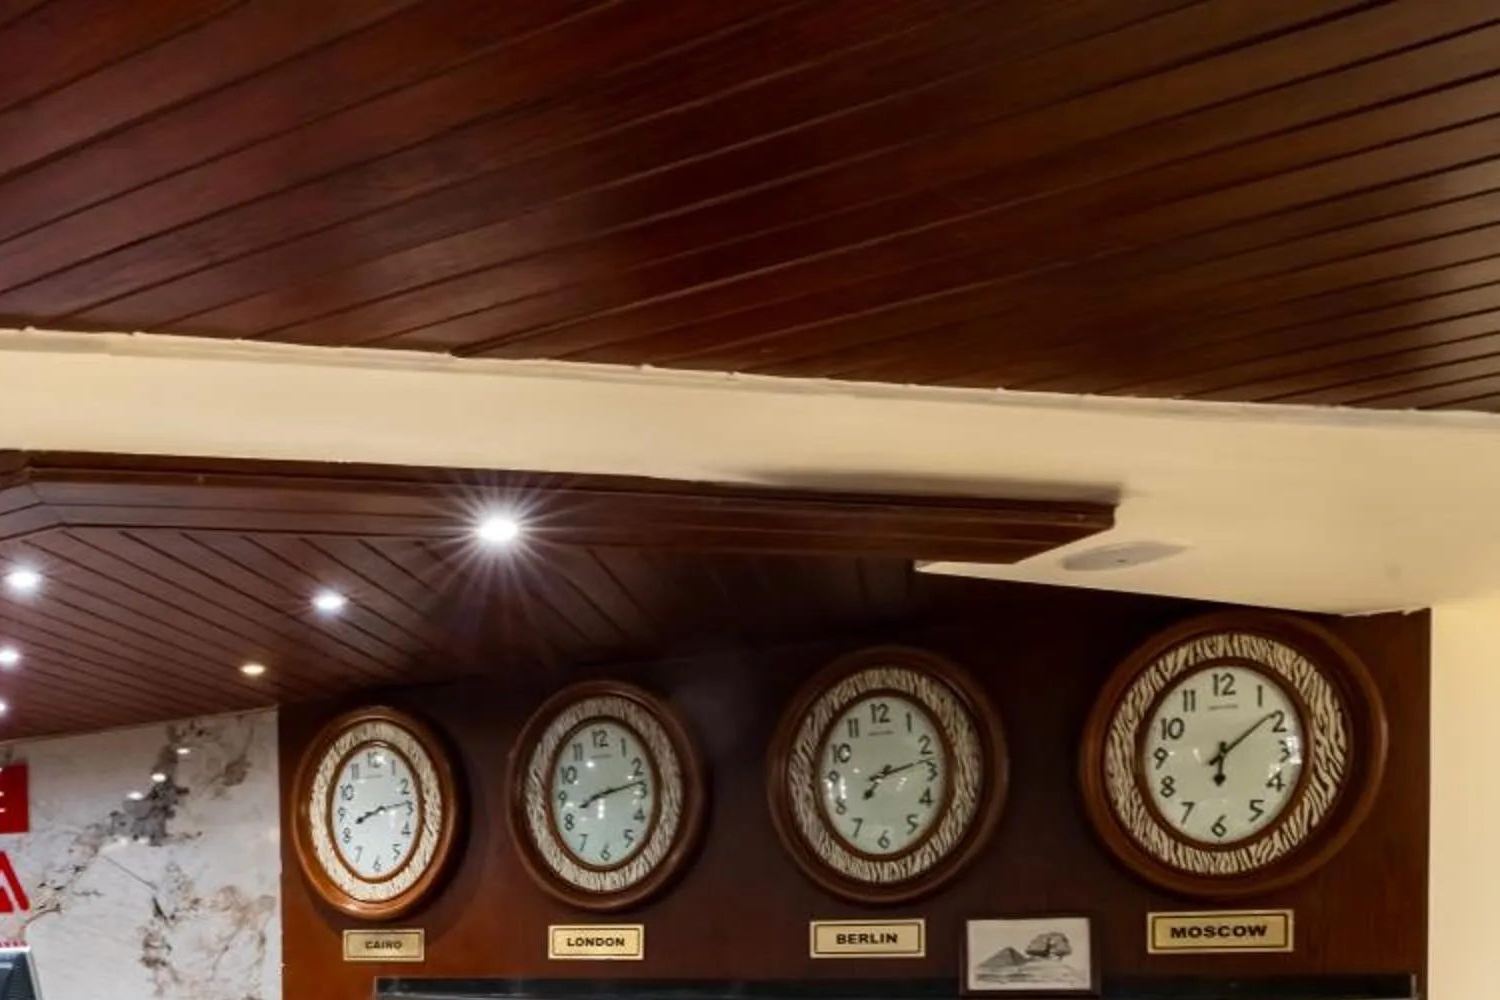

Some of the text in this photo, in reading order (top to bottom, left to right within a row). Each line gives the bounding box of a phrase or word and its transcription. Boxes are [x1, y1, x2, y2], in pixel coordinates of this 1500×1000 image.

[1212, 672, 1237, 697] 12
[1182, 689, 1196, 712] 11
[1256, 685, 1263, 708] 1
[869, 703, 891, 724] 12
[906, 712, 912, 733] 1
[1271, 710, 1287, 733] 2
[847, 717, 859, 738] 11
[1161, 717, 1185, 740] 10
[591, 730, 609, 749] 12
[918, 735, 933, 755] 2
[572, 743, 583, 762] 11
[832, 743, 851, 763] 10
[1153, 747, 1169, 770] 9
[1278, 739, 1291, 763] 3
[351, 763, 359, 780] 11
[561, 765, 578, 784] 10
[631, 757, 644, 776] 2
[925, 759, 938, 782] 3
[400, 778, 410, 795] 2
[1160, 776, 1176, 798] 8
[1266, 771, 1286, 792] 4
[339, 783, 354, 801] 10
[558, 790, 567, 808] 9
[918, 787, 933, 807] 4
[338, 806, 345, 822] 9
[633, 807, 646, 822] 4
[1180, 801, 1195, 825] 7
[1249, 799, 1264, 822] 5
[401, 821, 411, 837] 4
[564, 813, 574, 831] 8
[852, 817, 863, 838] 7
[906, 814, 918, 835] 5
[1211, 814, 1227, 838] 6
[342, 827, 352, 844] 8
[579, 833, 588, 852] 7
[623, 829, 634, 848] 5
[877, 829, 891, 849] 6
[354, 845, 363, 864] 7
[392, 843, 400, 860] 5
[600, 843, 611, 860] 6
[372, 855, 382, 872] 6
[835, 932, 899, 945] BERLIN
[1170, 924, 1268, 939] MOSCOW
[566, 937, 626, 947] LONDON
